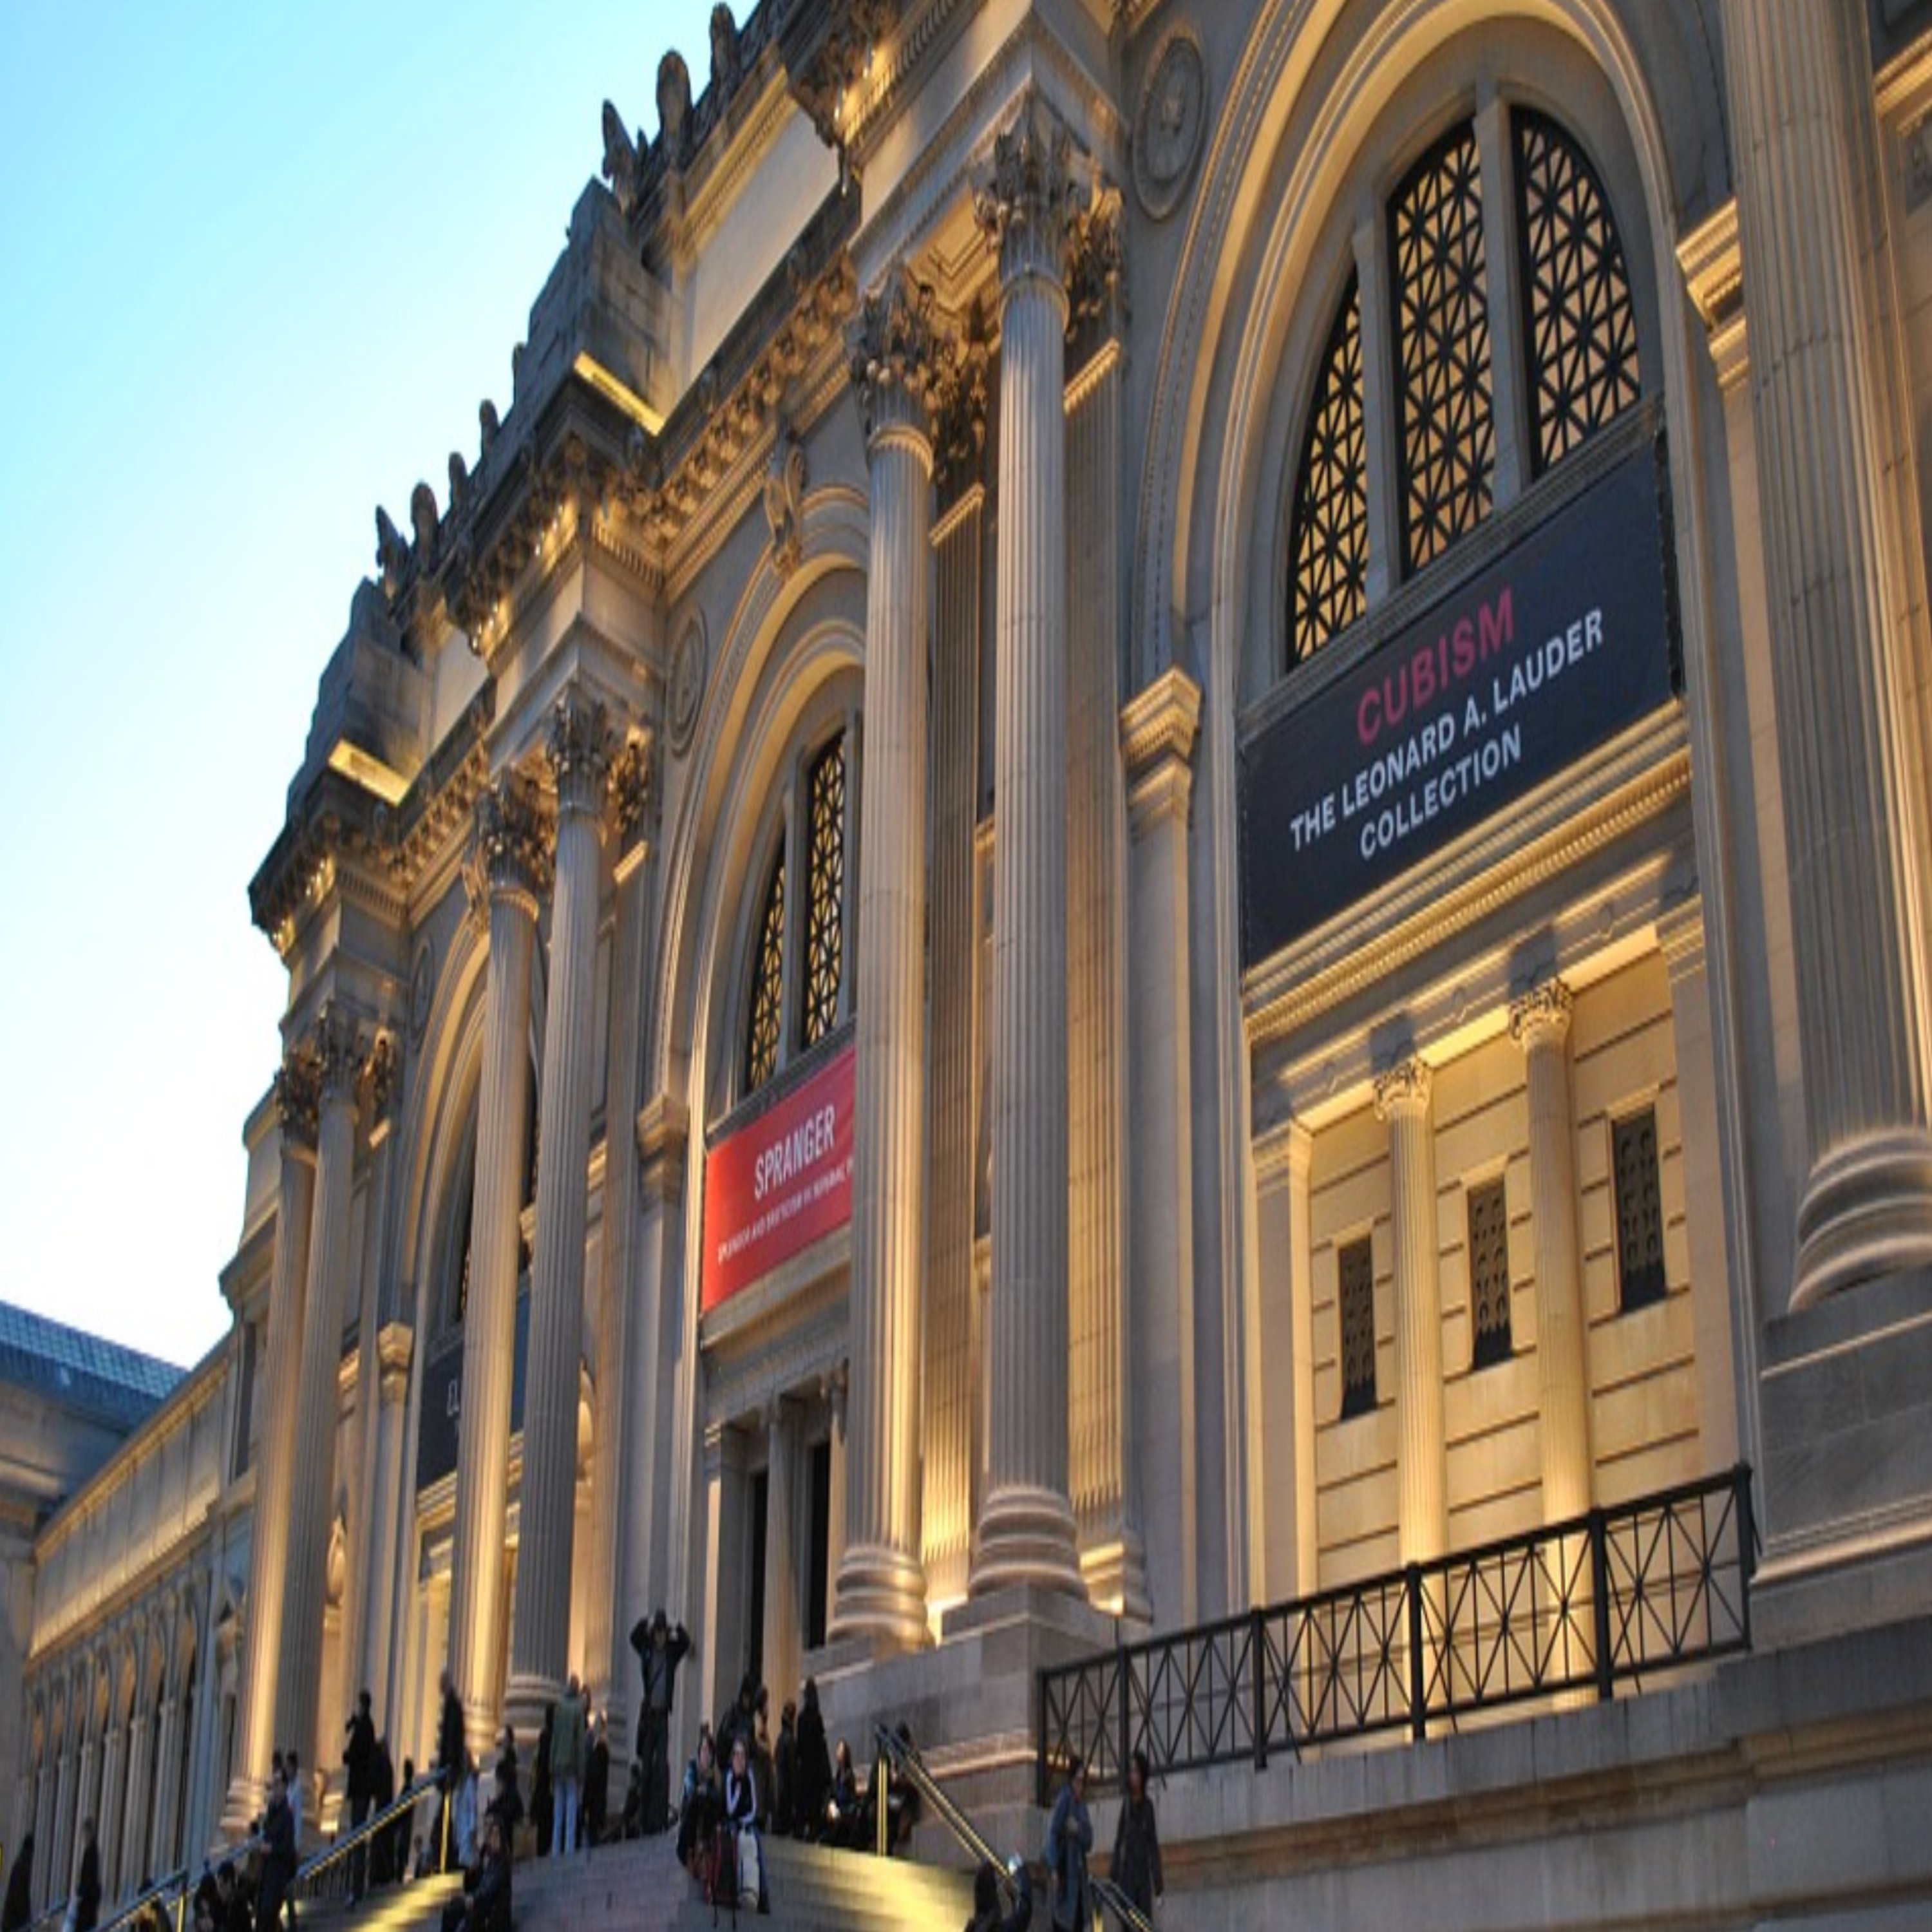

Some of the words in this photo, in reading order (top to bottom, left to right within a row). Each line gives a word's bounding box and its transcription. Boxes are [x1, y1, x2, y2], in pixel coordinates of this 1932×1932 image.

[1291, 793, 1336, 850] THE
[1343, 714, 1456, 814] LEONARD
[1463, 696, 1486, 736] A.
[1493, 608, 1604, 714] LAUDER
[1356, 589, 1515, 745] CUBISM
[1359, 725, 1521, 859] COLLECTION
[754, 1104, 835, 1202] SPRANGER
